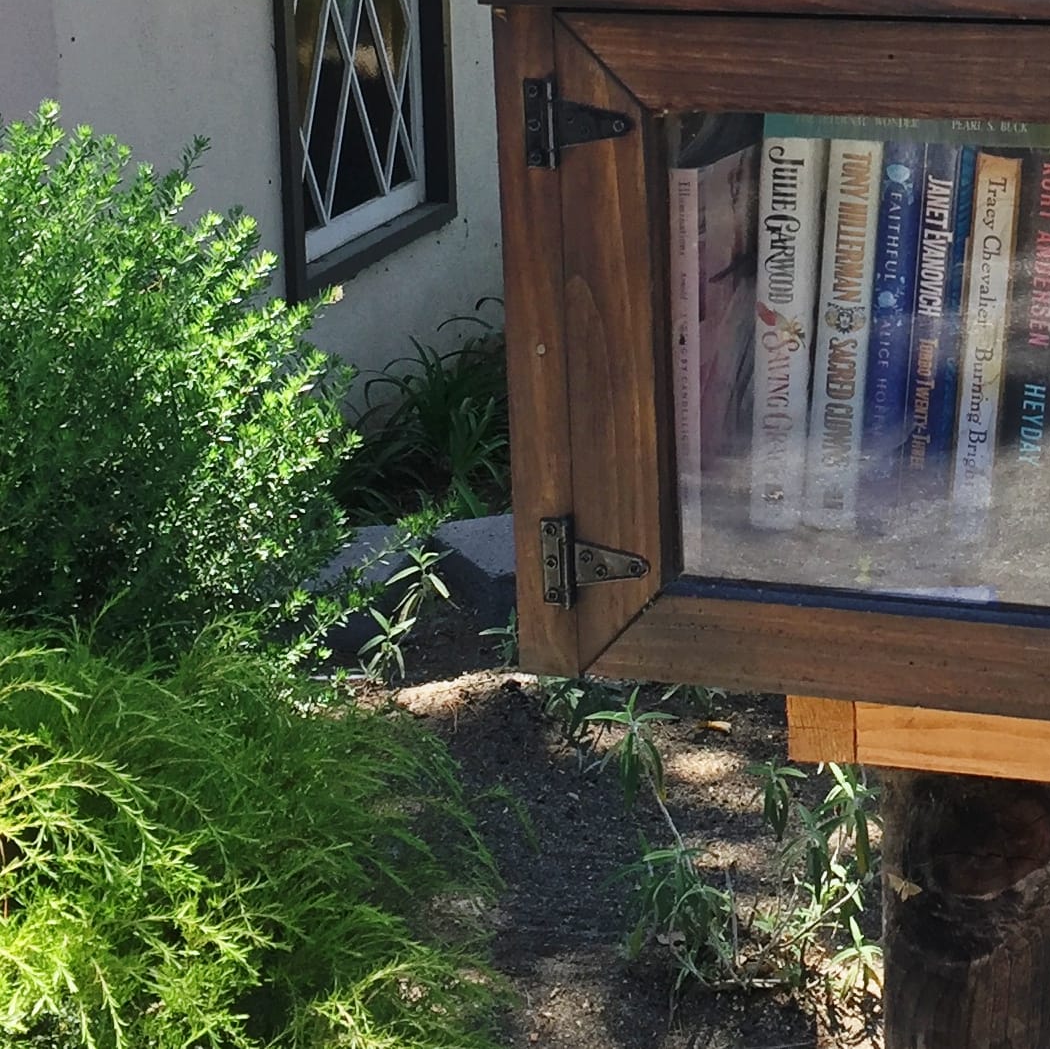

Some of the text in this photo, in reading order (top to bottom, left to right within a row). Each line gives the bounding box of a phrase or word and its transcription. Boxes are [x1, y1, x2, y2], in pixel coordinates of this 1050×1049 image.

[766, 145, 805, 304] JULIE GARWOOD
[835, 151, 873, 302] TONY HILLERMAN
[885, 190, 903, 282] FAITHFUL
[920, 174, 955, 318] JANET EVANOVICH
[979, 176, 1008, 329] Tracy Chevalier
[764, 330, 801, 408] SAVING
[828, 336, 857, 400] SACRED
[879, 317, 893, 369] ALICE
[969, 346, 995, 426] Burning
[1019, 382, 1047, 468] HEYDAY
